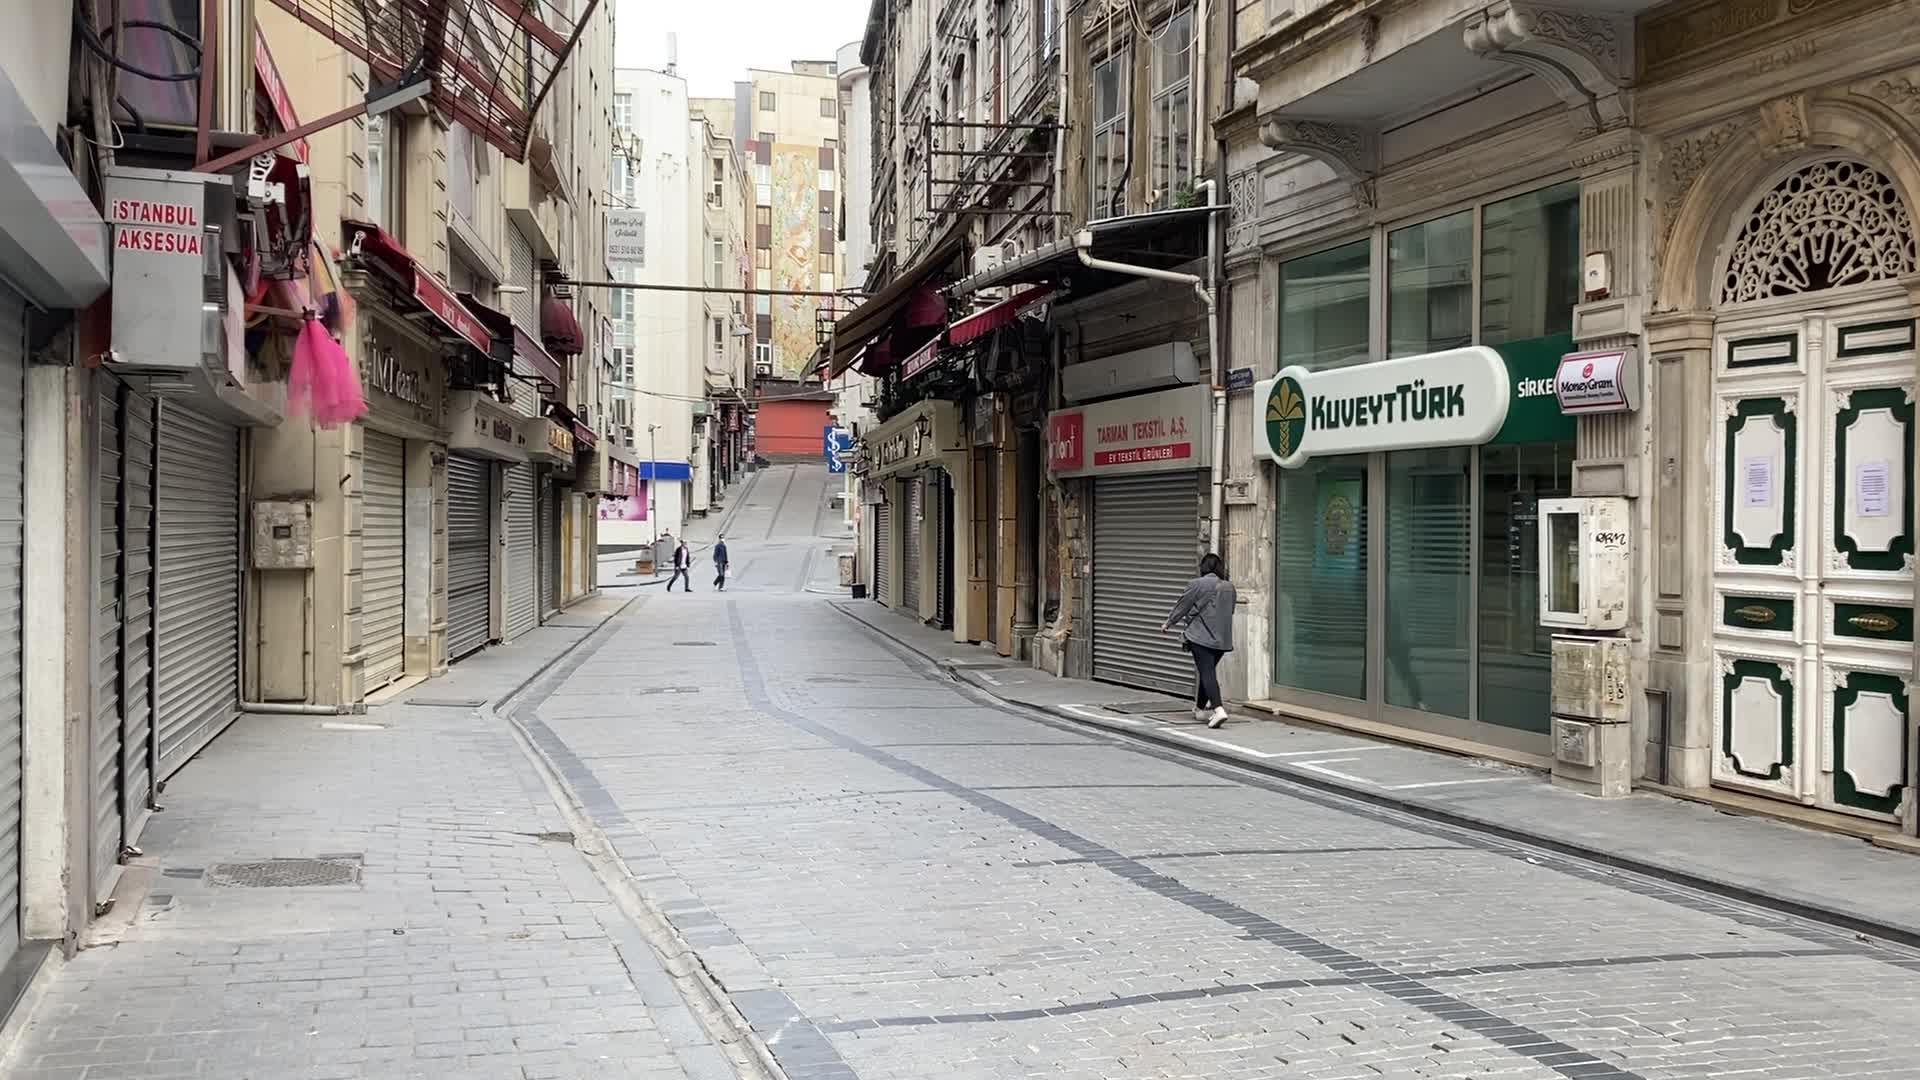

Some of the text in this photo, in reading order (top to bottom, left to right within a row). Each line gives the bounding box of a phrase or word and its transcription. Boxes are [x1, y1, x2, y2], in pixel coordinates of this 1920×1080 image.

[118, 229, 203, 255] AKSESUA
[1097, 423, 1128, 444] TARMAN
[1132, 416, 1166, 440] TEKSTİL
